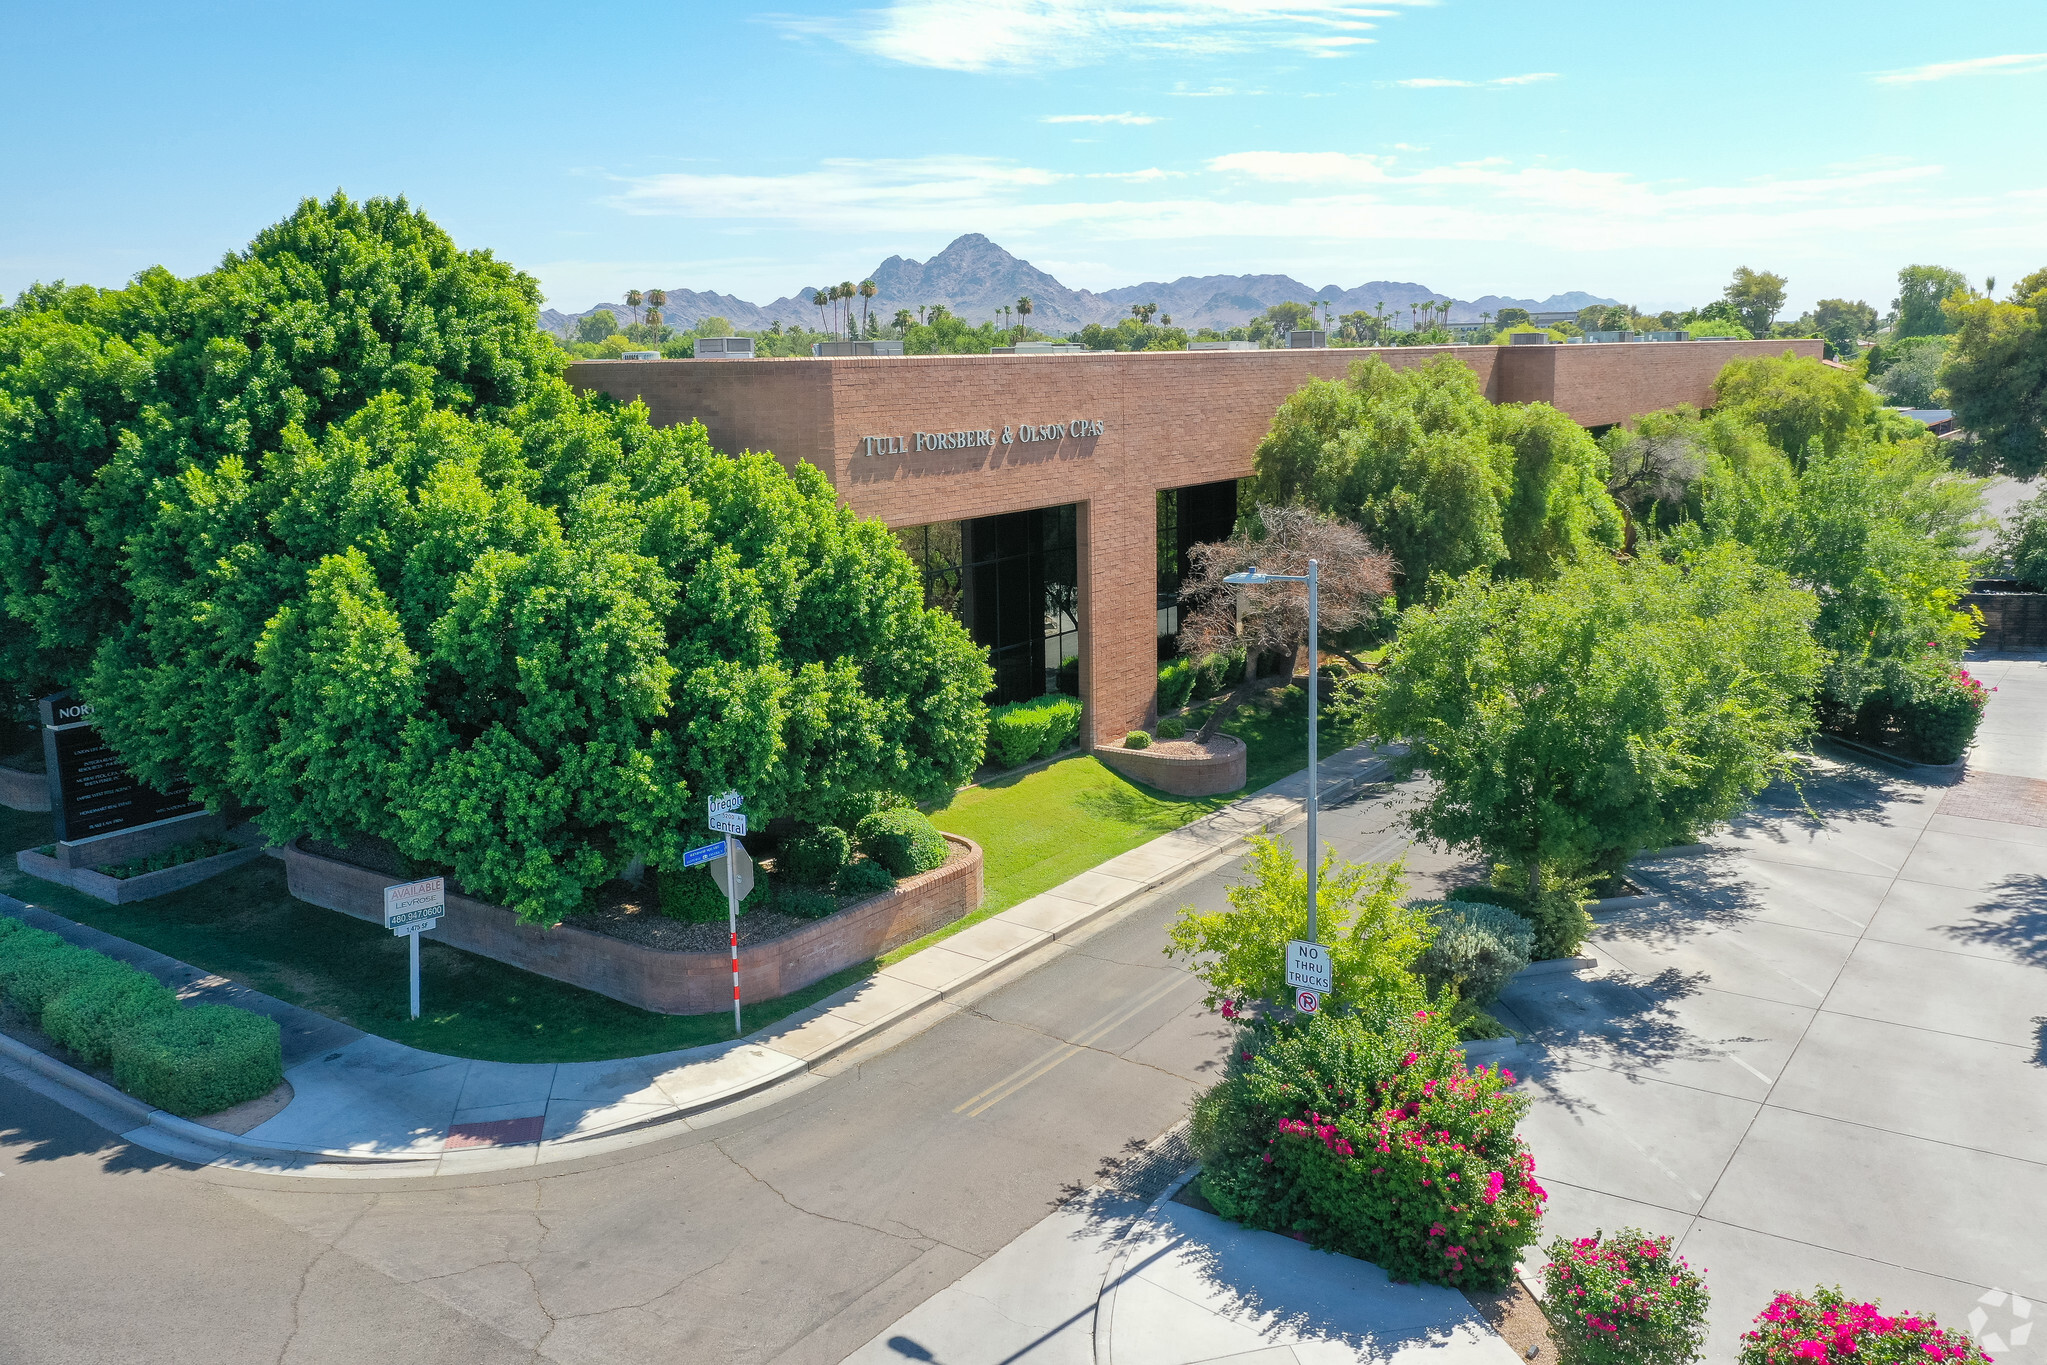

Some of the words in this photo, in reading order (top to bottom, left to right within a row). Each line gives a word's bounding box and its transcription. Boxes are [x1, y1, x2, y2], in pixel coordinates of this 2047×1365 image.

[863, 435, 908, 457] TULL
[914, 428, 996, 452] FORSBERG
[1001, 425, 1014, 445] &
[1019, 423, 1066, 443] OLSON
[709, 796, 743, 813] Oregon
[709, 817, 744, 835] Central
[391, 880, 441, 900] AVAILABLE
[391, 905, 442, 924] 480.947.0600
[1299, 945, 1318, 960] NO
[1295, 959, 1323, 974] THRU
[1289, 971, 1329, 988] TRUCKS
